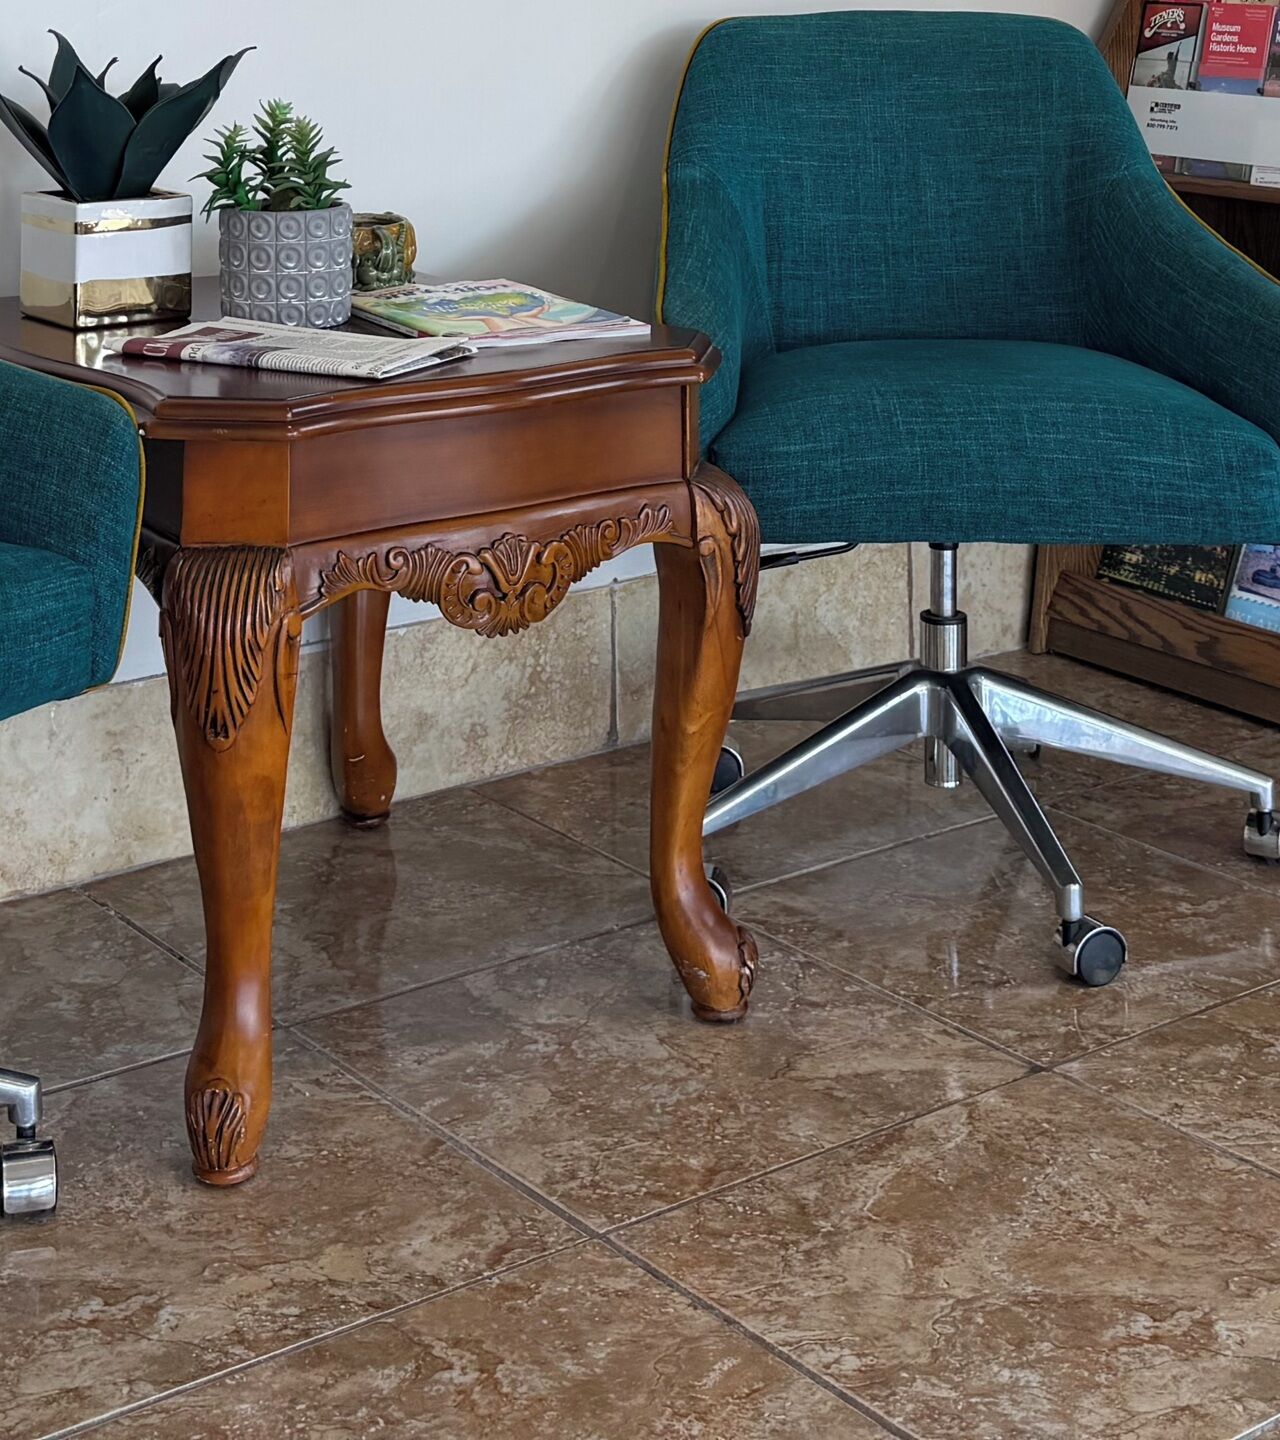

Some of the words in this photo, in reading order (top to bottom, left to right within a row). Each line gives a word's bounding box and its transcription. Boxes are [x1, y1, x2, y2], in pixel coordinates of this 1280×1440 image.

[1212, 22, 1241, 33] Museum
[1210, 33, 1239, 43] Gardens
[1209, 43, 1236, 53] Historic
[1236, 45, 1257, 54] Home
